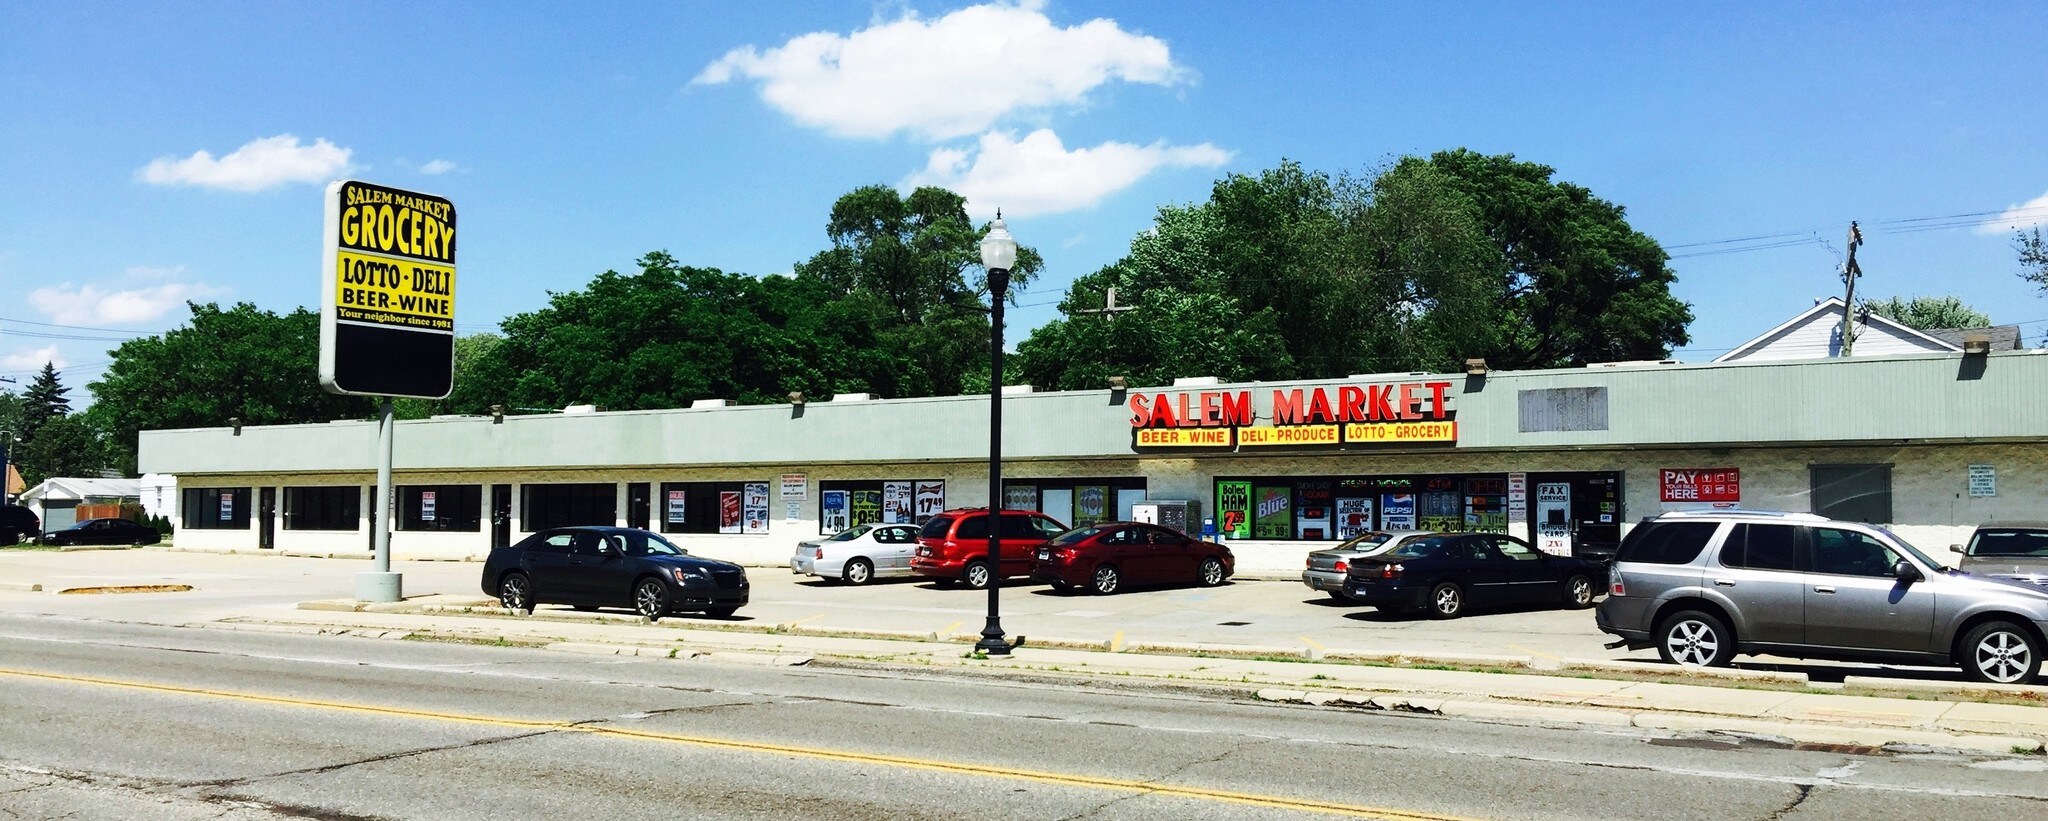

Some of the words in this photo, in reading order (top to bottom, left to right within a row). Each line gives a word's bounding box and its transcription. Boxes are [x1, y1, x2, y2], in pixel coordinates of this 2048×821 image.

[347, 186, 393, 206] SALEM
[395, 194, 450, 222] MARKET
[341, 204, 455, 260] GROCERY
[343, 257, 401, 290] LOTTO
[411, 267, 451, 296] DELI
[339, 307, 363, 320] Your
[364, 311, 407, 325] neighbor
[407, 315, 430, 327] since
[432, 319, 451, 330] 1981
[1129, 390, 1254, 428] SALEM
[1272, 381, 1453, 426] MARKET
[1140, 430, 1180, 444] BEER
[1189, 429, 1226, 443] WINE
[1241, 429, 1269, 442] DELI
[1276, 427, 1336, 442] PRODUCE
[1347, 425, 1386, 439] LOTTO
[1395, 423, 1450, 439] GROCERY
[1664, 470, 1699, 484] PAY
[1223, 483, 1246, 494] Boiled
[1542, 486, 1564, 495] FAX
[1665, 489, 1698, 499] HERE
[1221, 494, 1248, 510] HAM
[1257, 496, 1289, 519] Blue
[1340, 527, 1370, 537] ITEMS
